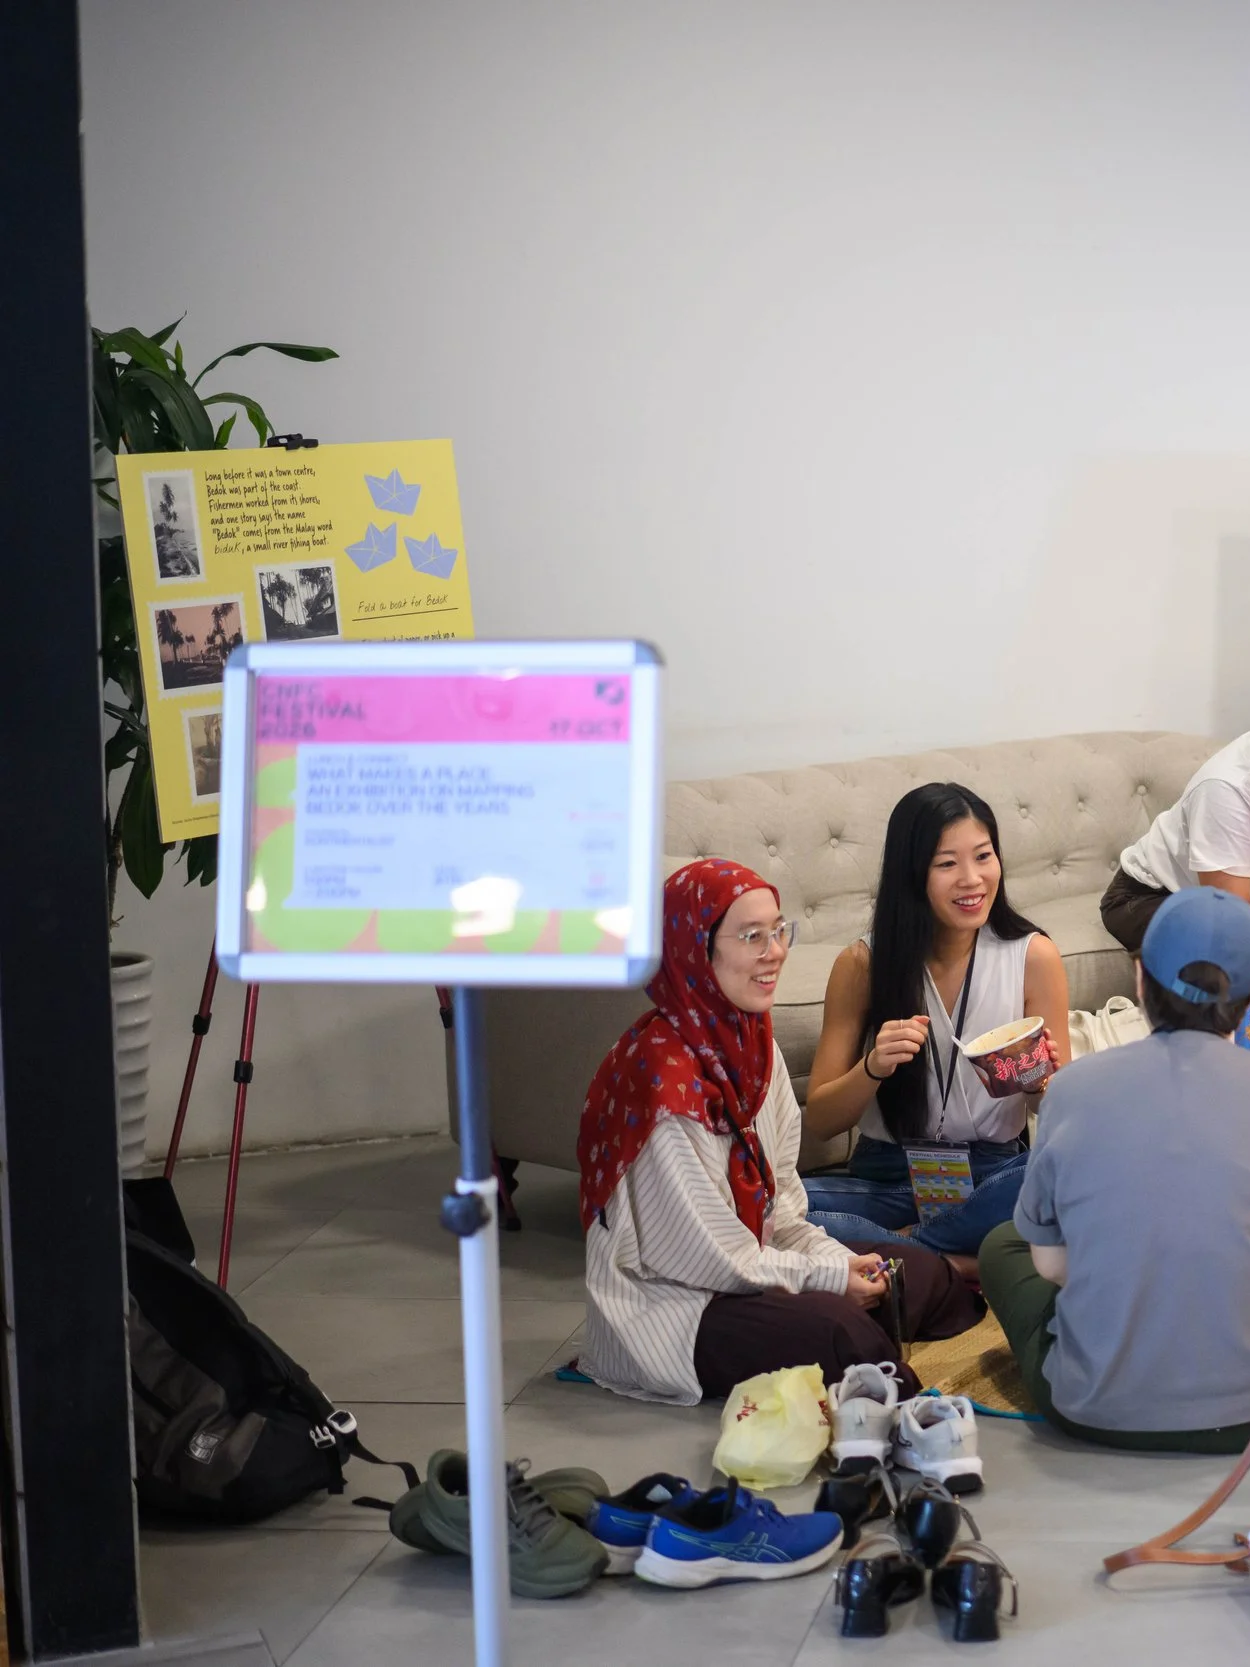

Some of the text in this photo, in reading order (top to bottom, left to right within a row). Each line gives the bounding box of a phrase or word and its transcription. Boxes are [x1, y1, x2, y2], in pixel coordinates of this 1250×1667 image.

[205, 470, 221, 485] Long
[223, 468, 245, 484] before
[247, 467, 252, 479] it
[254, 469, 267, 479] was
[275, 466, 292, 477] town
[294, 464, 316, 477] centre,
[206, 484, 227, 497] Bedok
[229, 487, 242, 496] was
[243, 482, 258, 498] part
[260, 481, 268, 498] of
[270, 481, 280, 492] the
[208, 498, 243, 512] Fishermen
[246, 496, 269, 508] worked
[271, 495, 288, 511] from
[289, 494, 298, 506] its
[210, 509, 306, 527] and one story says the name
[212, 520, 333, 542] "Bedok" comes from the Malay word
[246, 544, 252, 552] a
[253, 538, 272, 552] small
[273, 540, 288, 549] river
[290, 537, 310, 552] fishing
[358, 600, 376, 613] Fold
[380, 602, 386, 610] a
[390, 599, 407, 609] boat
[411, 596, 422, 607] for
[261, 701, 366, 721] FESTIVAL
[307, 765, 355, 781] WHAT
[358, 765, 417, 780] MAKES
[420, 766, 433, 780] A
[307, 783, 536, 798] AN EXHIBITION ON MAPPING
[305, 800, 511, 815] BEDOK OVER THE YEARS
